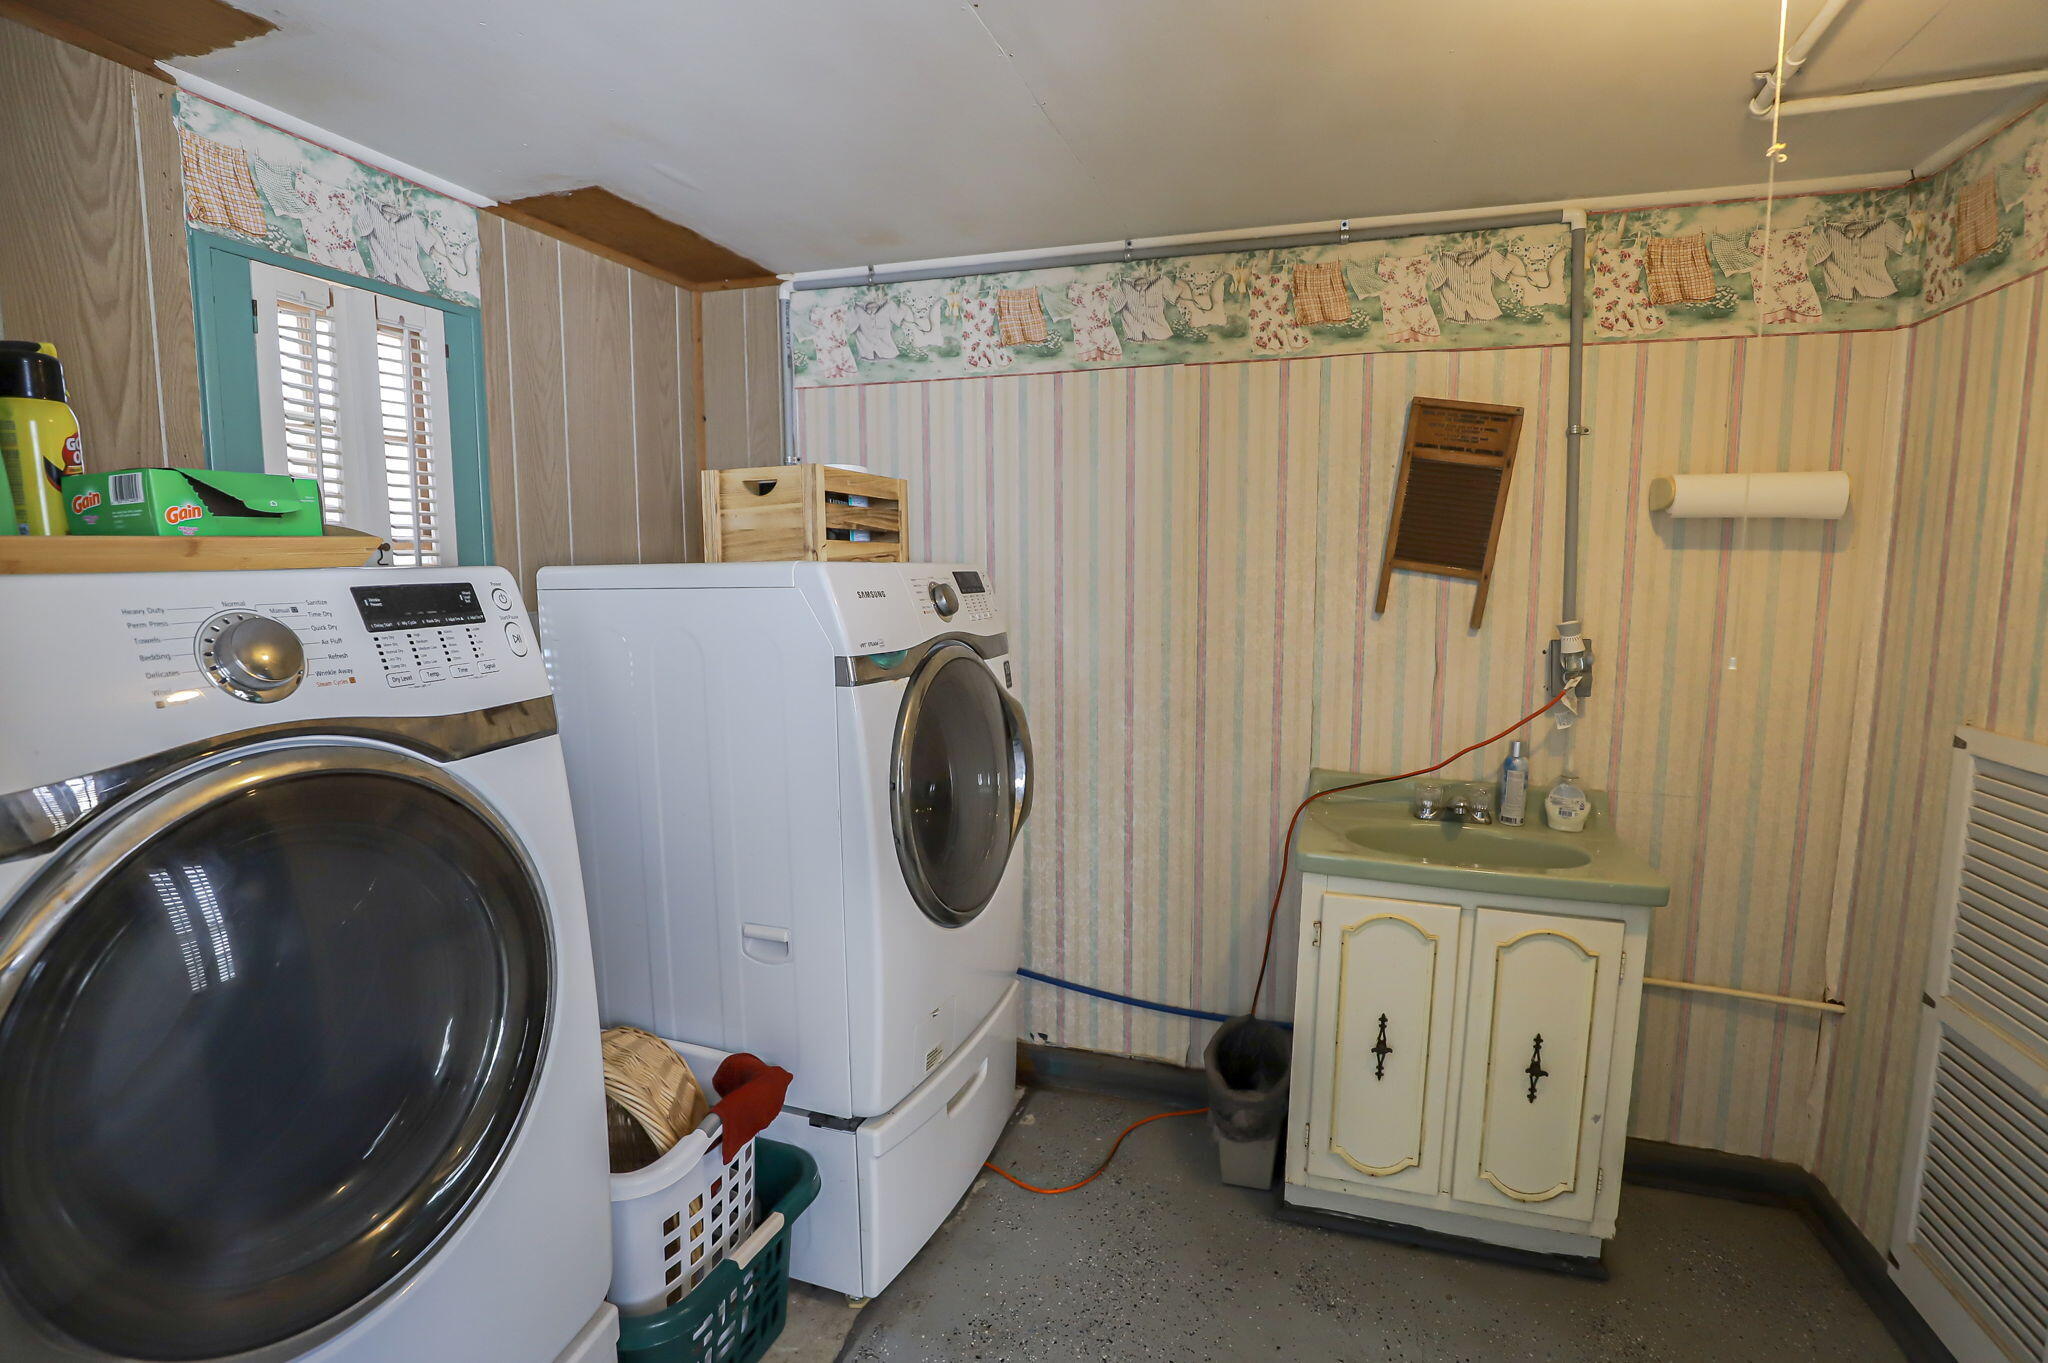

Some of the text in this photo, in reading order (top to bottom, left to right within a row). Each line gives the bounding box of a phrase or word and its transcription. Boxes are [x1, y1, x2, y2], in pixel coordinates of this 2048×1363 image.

[72, 492, 102, 514] Gain
[164, 504, 203, 525] Gain
[856, 590, 886, 599] SAMSUNG
[121, 607, 165, 616] Heavy Duty
[126, 620, 169, 629] Perm Press
[327, 624, 338, 632] Dry
[138, 653, 172, 662] Bedding
[327, 652, 348, 660] Refresh
[145, 670, 181, 679] Delicates
[338, 668, 353, 676] Away
[391, 674, 413, 684] Dry Level
